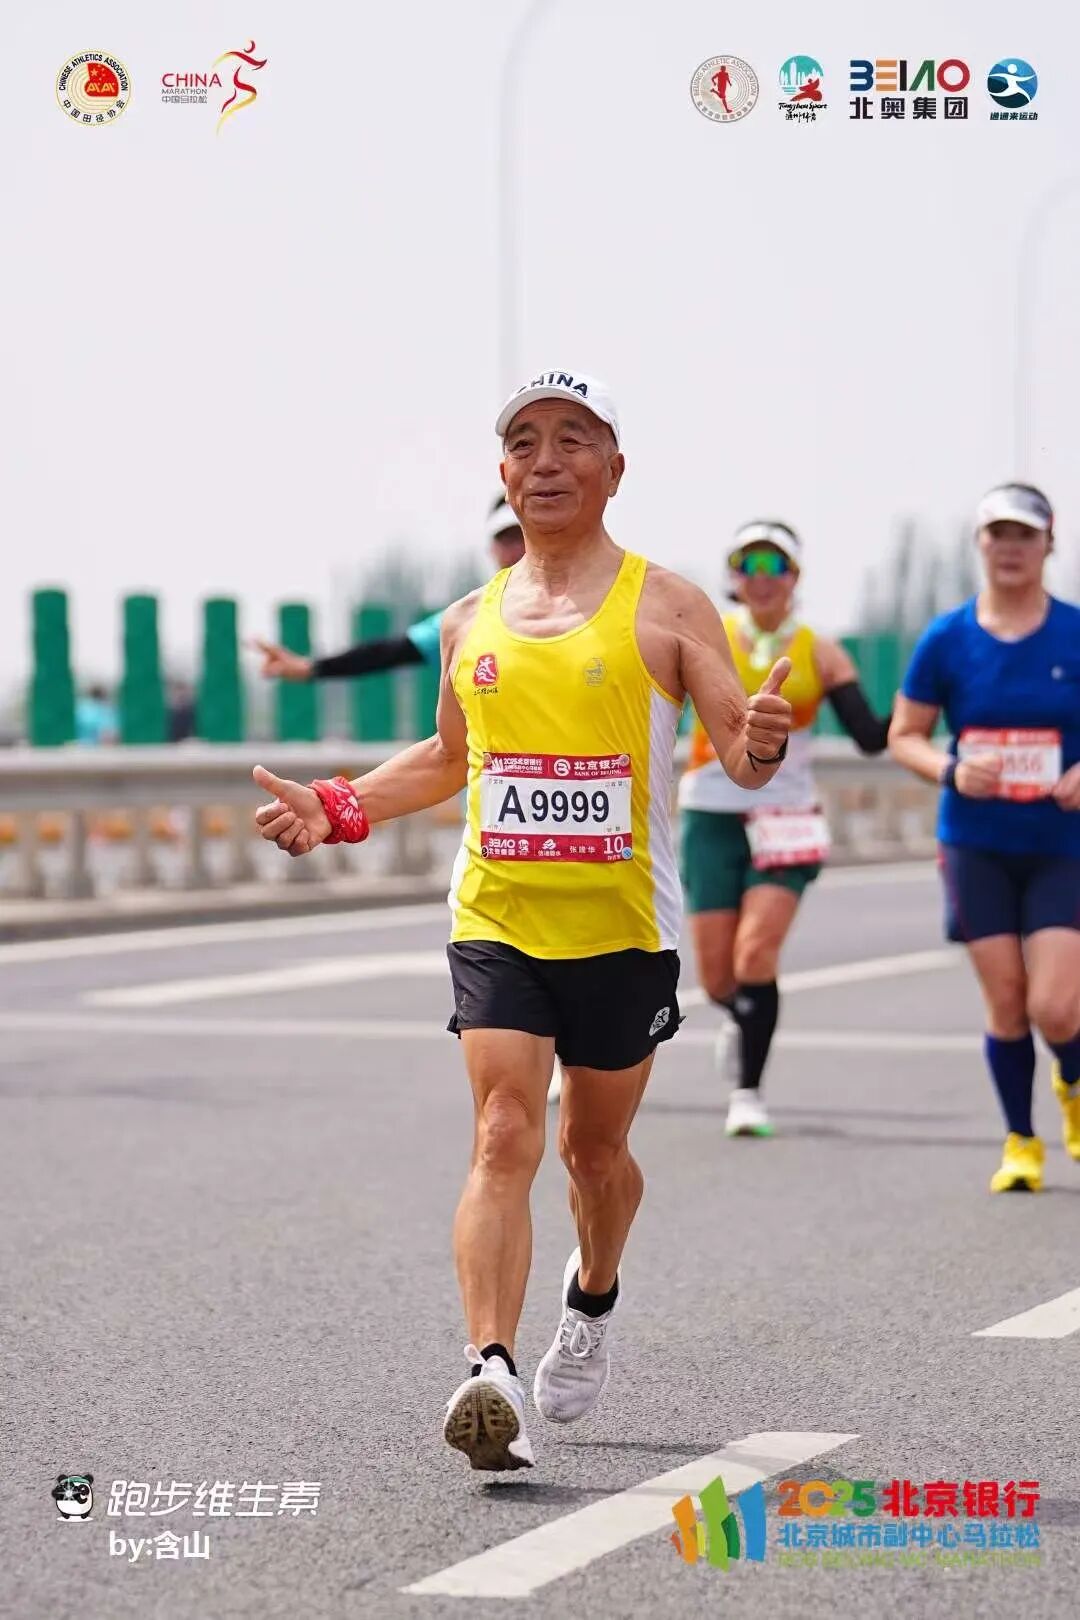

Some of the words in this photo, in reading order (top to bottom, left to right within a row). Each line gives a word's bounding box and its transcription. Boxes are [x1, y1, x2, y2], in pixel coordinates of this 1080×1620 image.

[517, 373, 589, 397] HINA
[498, 784, 610, 823] A9999
[603, 836, 624, 855] 10
